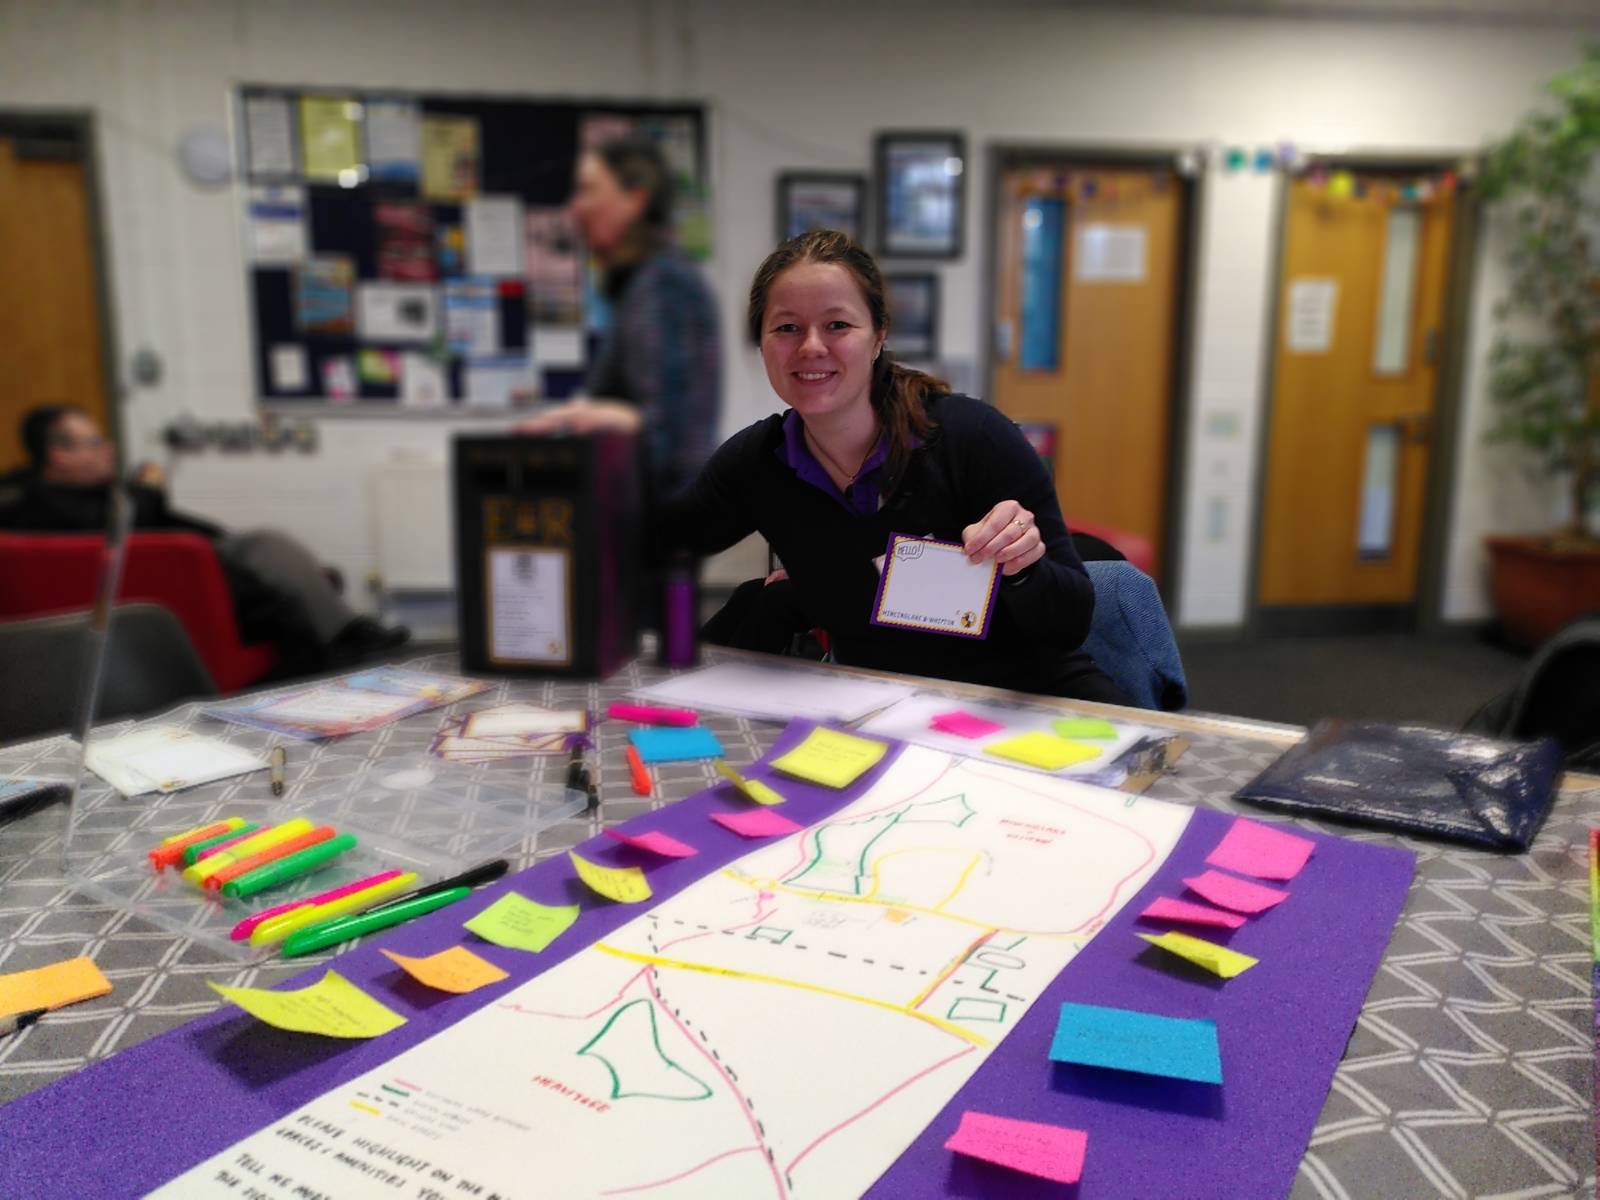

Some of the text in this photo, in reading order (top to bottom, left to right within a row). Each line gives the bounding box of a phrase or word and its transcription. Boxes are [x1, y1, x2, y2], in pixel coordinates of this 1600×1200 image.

[897, 543, 921, 555] HELLO!
[214, 1170, 241, 1187] THE
[235, 1153, 266, 1174] TELL
[267, 1174, 293, 1188] ME
[352, 1137, 432, 1173] HIGHLIGHT
[431, 1169, 454, 1182] ON
[455, 1180, 484, 1195] THE
